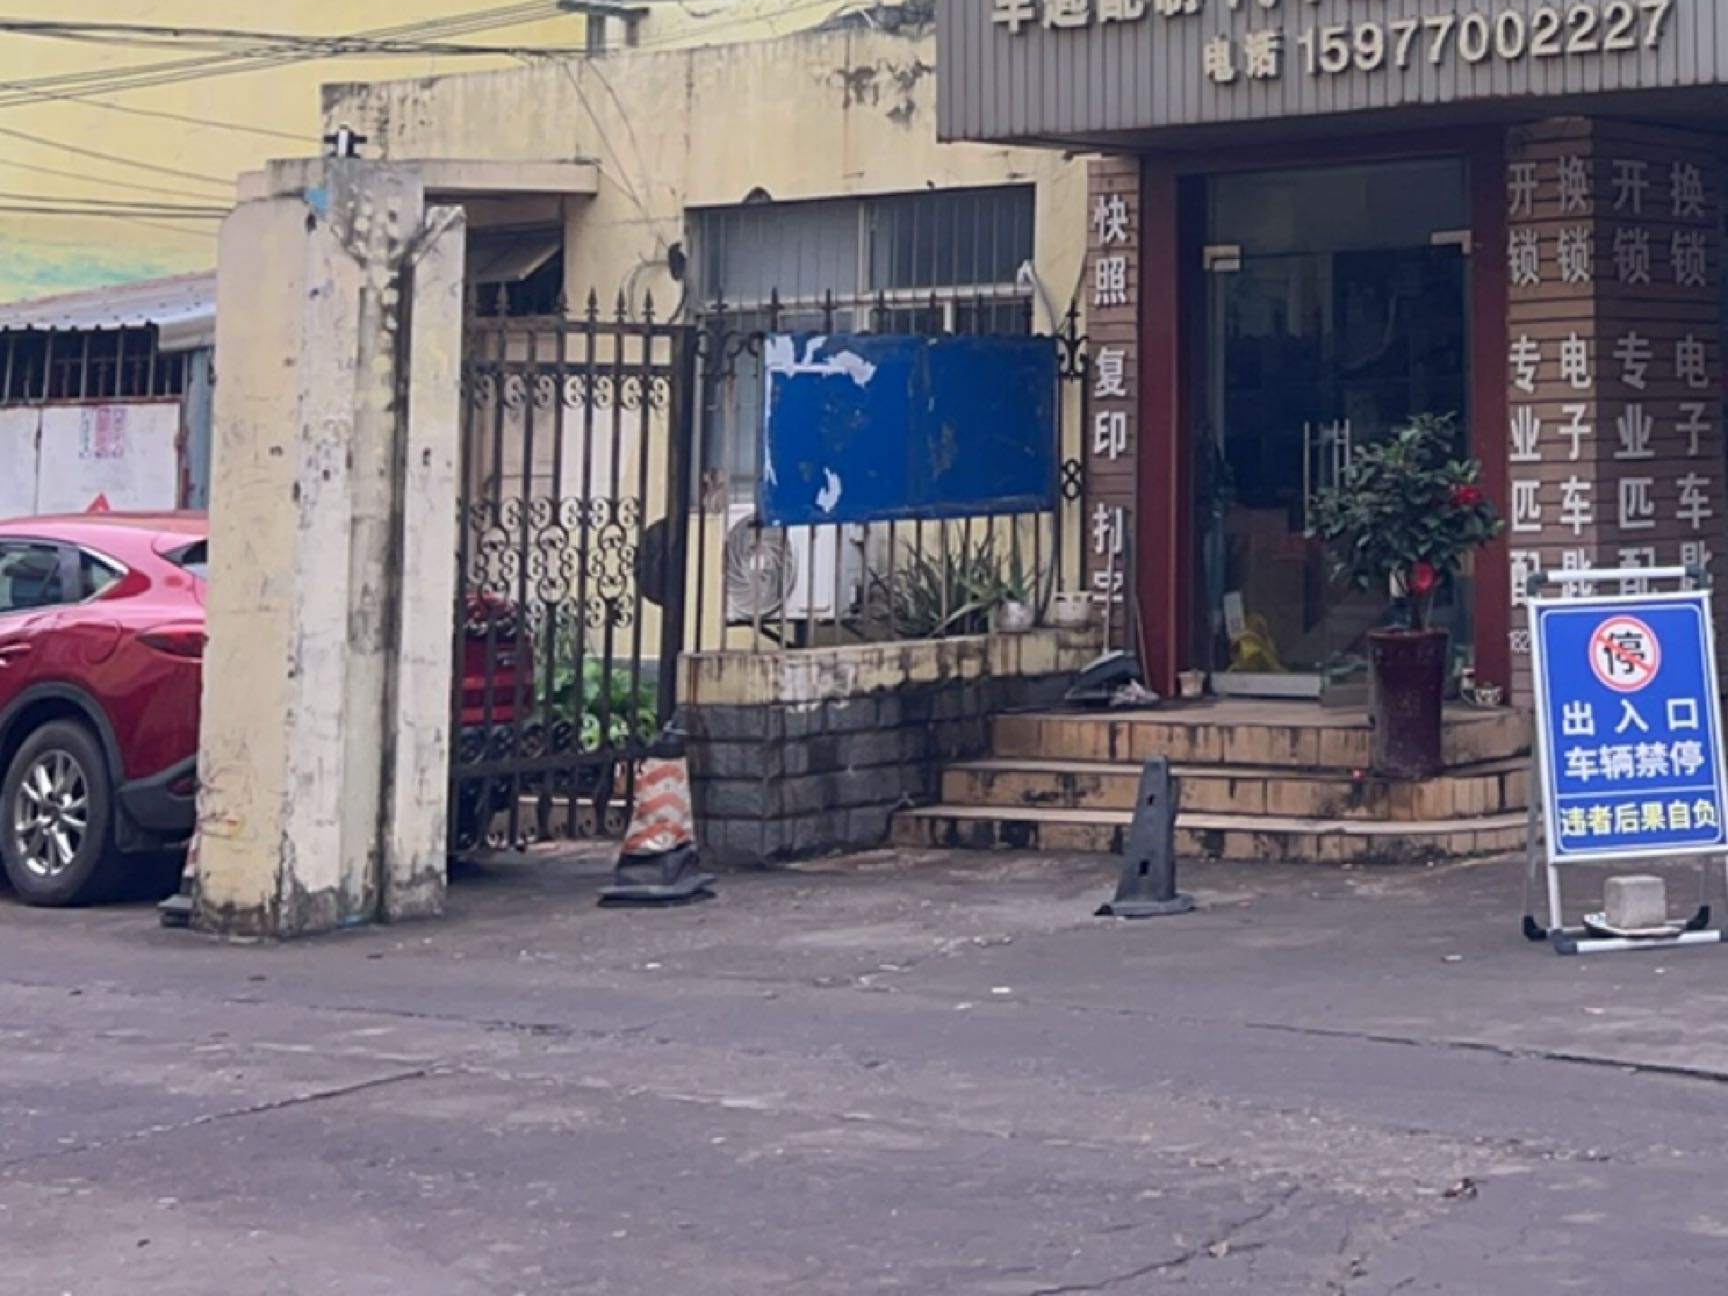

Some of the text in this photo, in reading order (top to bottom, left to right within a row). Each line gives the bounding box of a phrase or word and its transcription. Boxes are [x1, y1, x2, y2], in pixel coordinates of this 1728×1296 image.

[1203, 28, 1283, 84] 电话
[1093, 193, 1130, 306] 快照
[1556, 153, 1592, 285] 换锁
[1611, 158, 1651, 285] 开锁
[1669, 160, 1707, 288] 换锁
[1093, 346, 1128, 461] 复印
[1506, 161, 1543, 607] 开锁 专业匹配
[1562, 697, 1700, 737] 出入口
[1564, 740, 1706, 783] 车辆禁停
[1559, 797, 1719, 838] 违者后果自负
